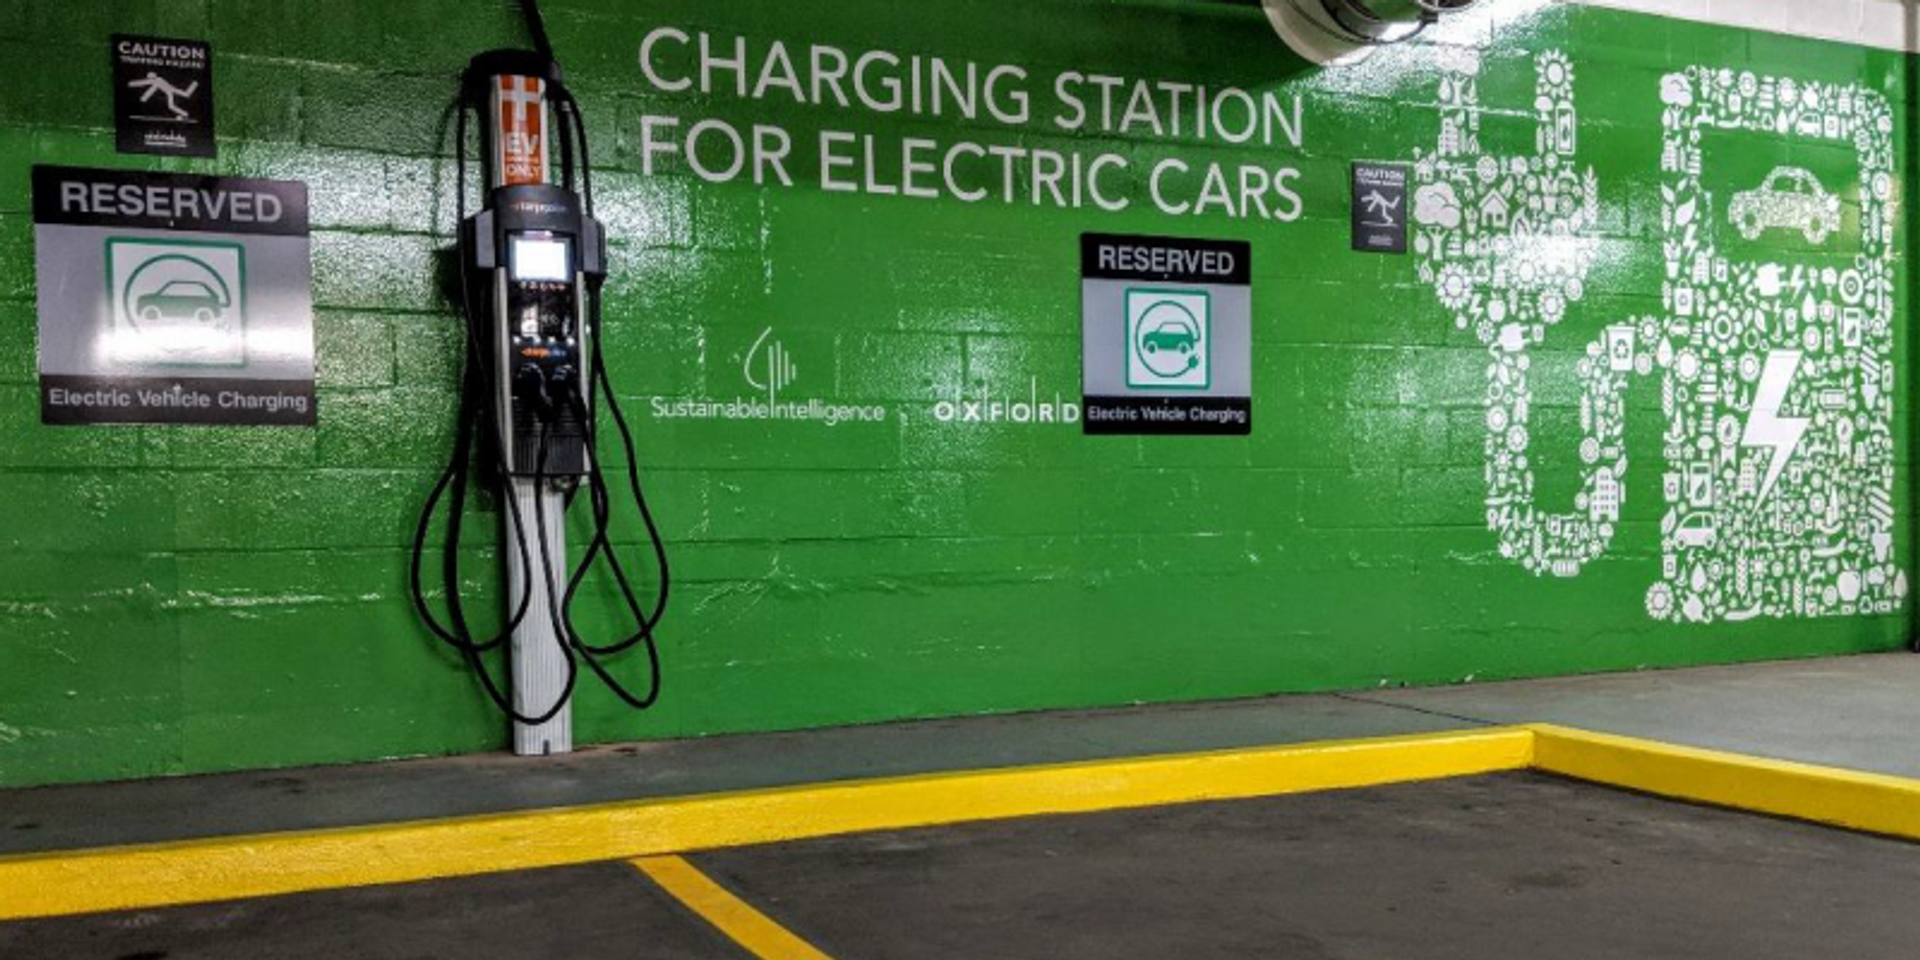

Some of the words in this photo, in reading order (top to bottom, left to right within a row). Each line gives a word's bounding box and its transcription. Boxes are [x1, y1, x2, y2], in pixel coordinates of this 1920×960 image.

[118, 40, 205, 59] CAUTION
[638, 26, 1030, 124] CHARGING
[1054, 70, 1303, 146] STATION
[505, 132, 539, 155] EV
[505, 163, 541, 178] ONLY
[639, 115, 794, 187] FOR
[819, 130, 1130, 212] ELECTRIC
[1149, 158, 1303, 223] CARS
[1356, 167, 1405, 181] CAUTION
[59, 181, 283, 222] RESERVED
[1098, 245, 1235, 275] RESERVED
[49, 388, 131, 407] Electric
[137, 390, 211, 408] Vehicle
[218, 390, 308, 413] Charging
[933, 400, 1080, 424] OXFORD
[1087, 406, 1138, 420] Electric
[1141, 406, 1186, 421] Vehicle
[1189, 406, 1246, 424] Charging
